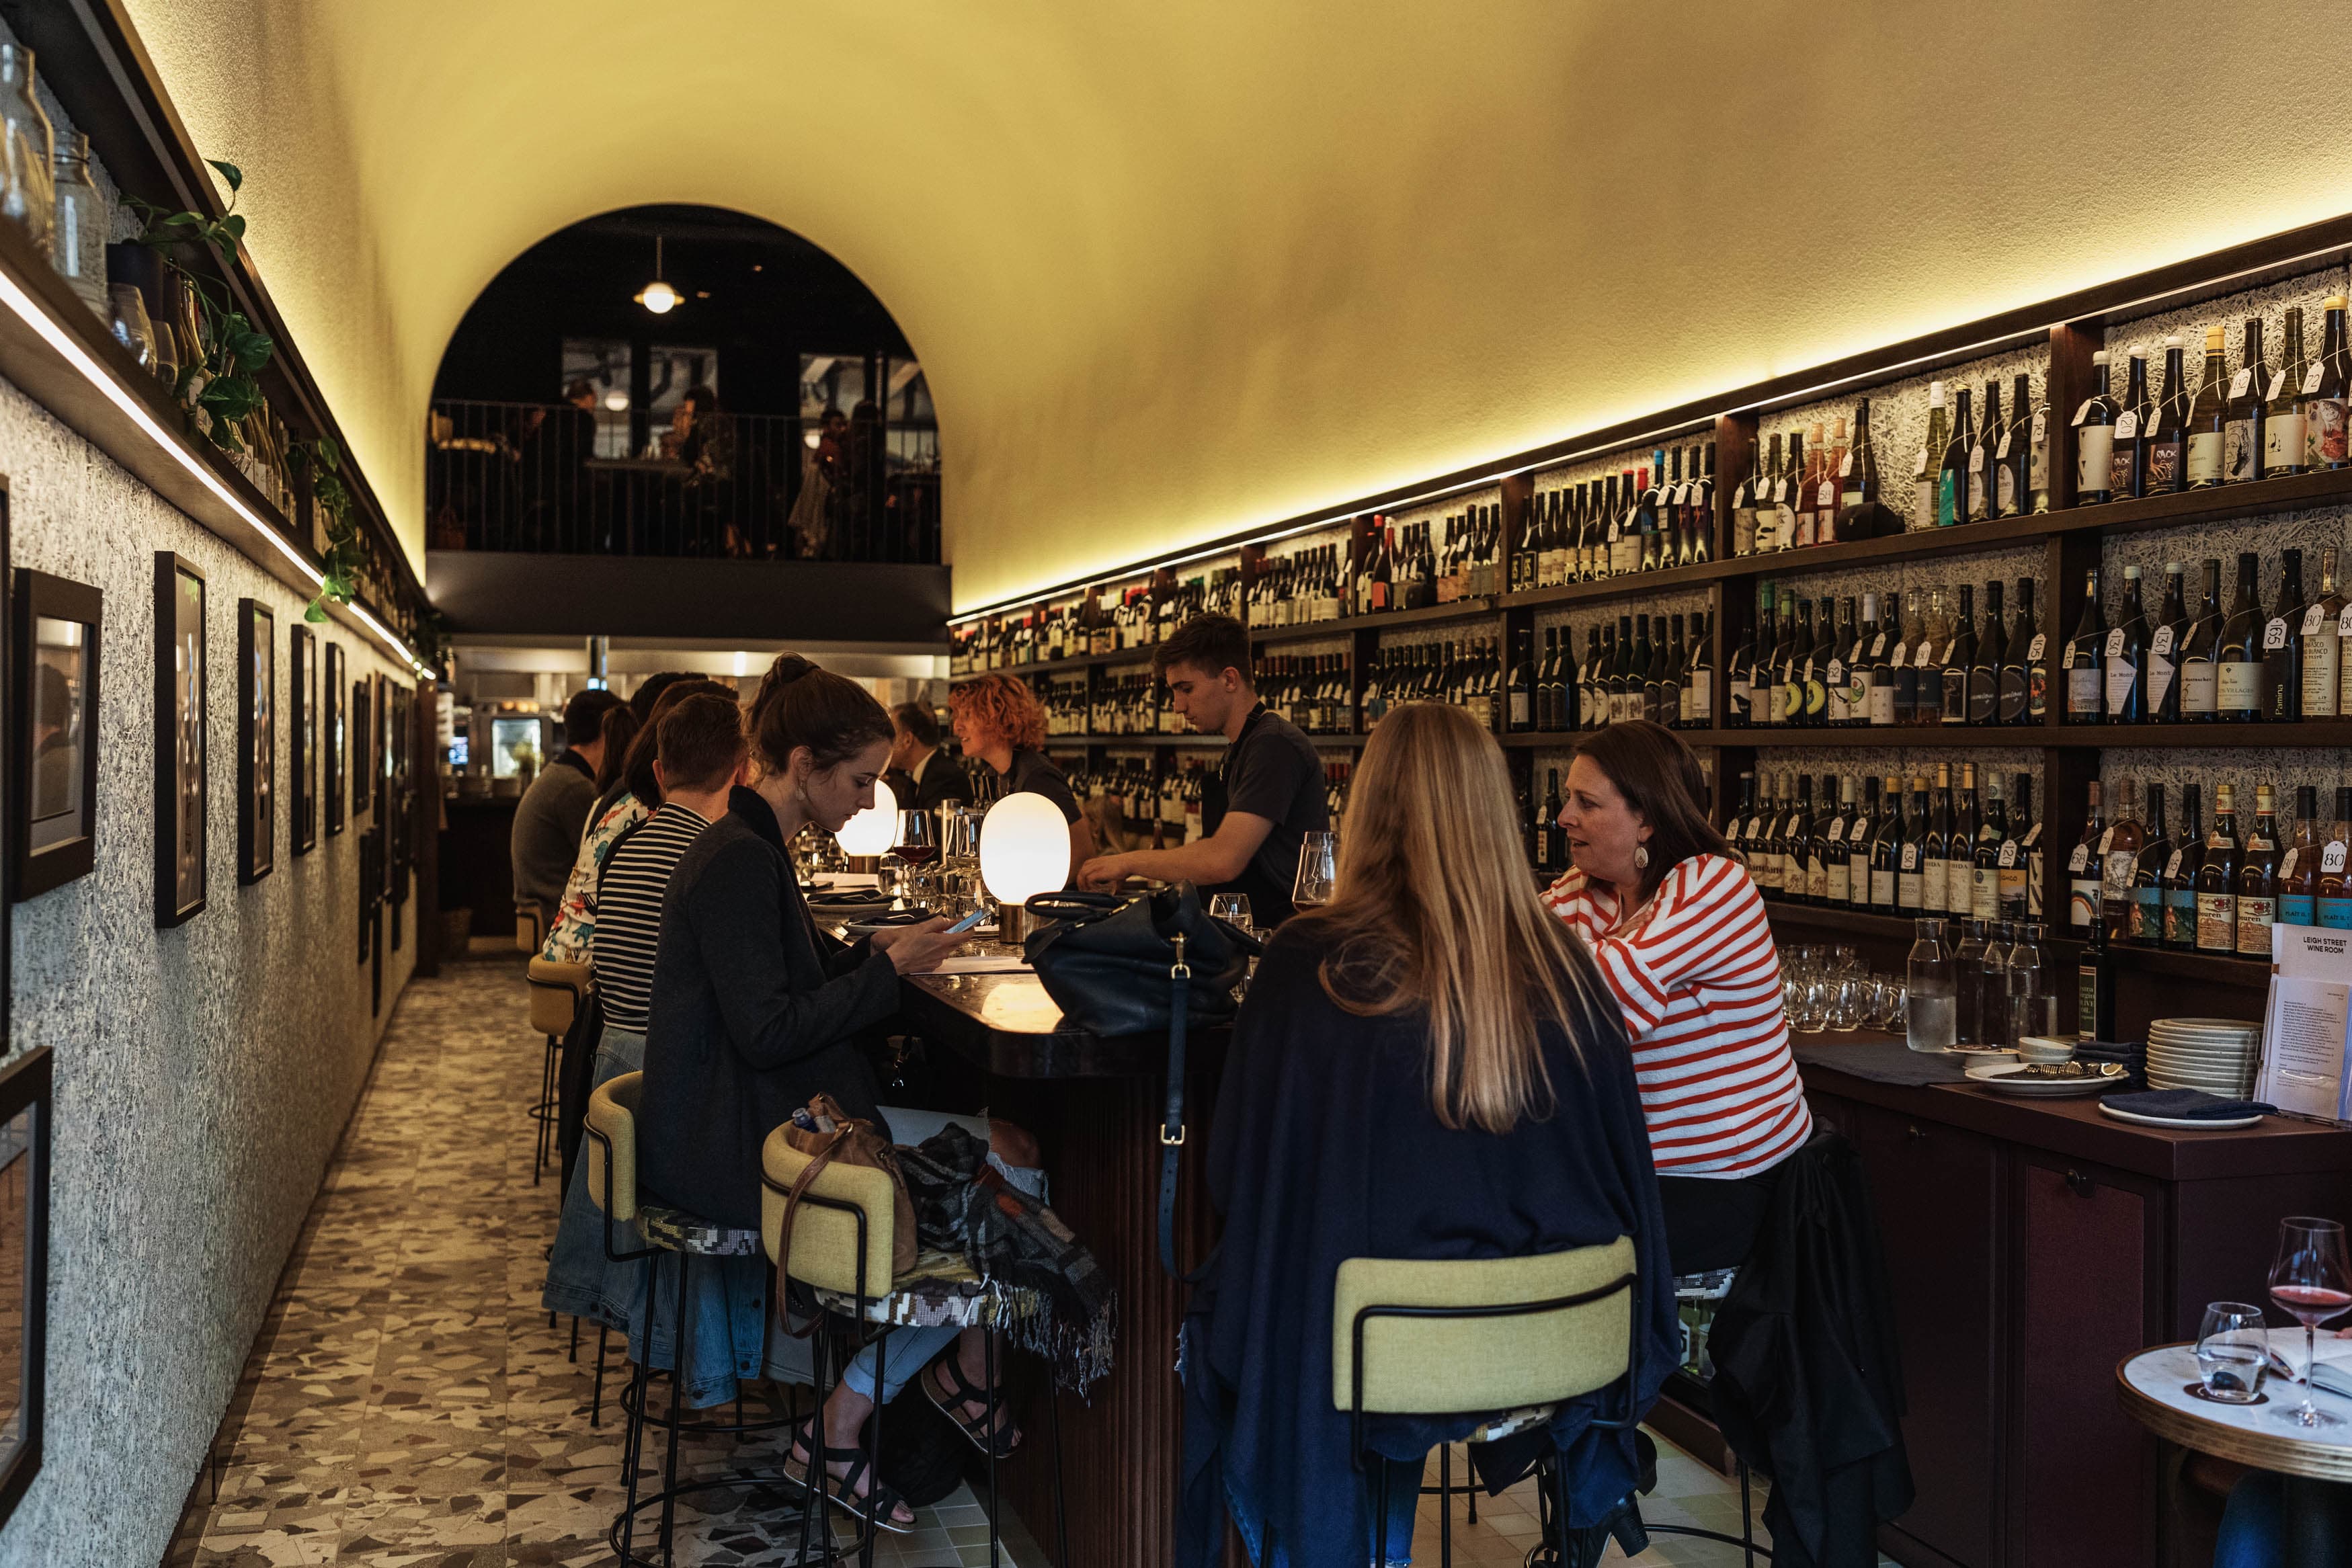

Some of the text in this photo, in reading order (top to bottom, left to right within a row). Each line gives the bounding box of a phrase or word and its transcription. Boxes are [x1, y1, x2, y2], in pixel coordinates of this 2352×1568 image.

[2307, 375, 2320, 388] 72
[2033, 424, 2043, 437] 75
[2121, 415, 2133, 434] 120
[2304, 615, 2321, 627] 80
[2267, 624, 2283, 645] 165
[2031, 639, 2043, 657] 105
[2109, 634, 2121, 656] 130
[2156, 632, 2170, 653] 130
[1828, 667, 1840, 678] 62
[2275, 684, 2283, 716] Pamina
[1904, 850, 1914, 868] 130
[2002, 845, 2015, 865] 120
[2071, 852, 2086, 864] 68
[2324, 854, 2345, 866] 80
[2281, 858, 2296, 870] 80
[2307, 944, 2345, 954] WINE ROOM
[2323, 938, 2347, 947] STREET
